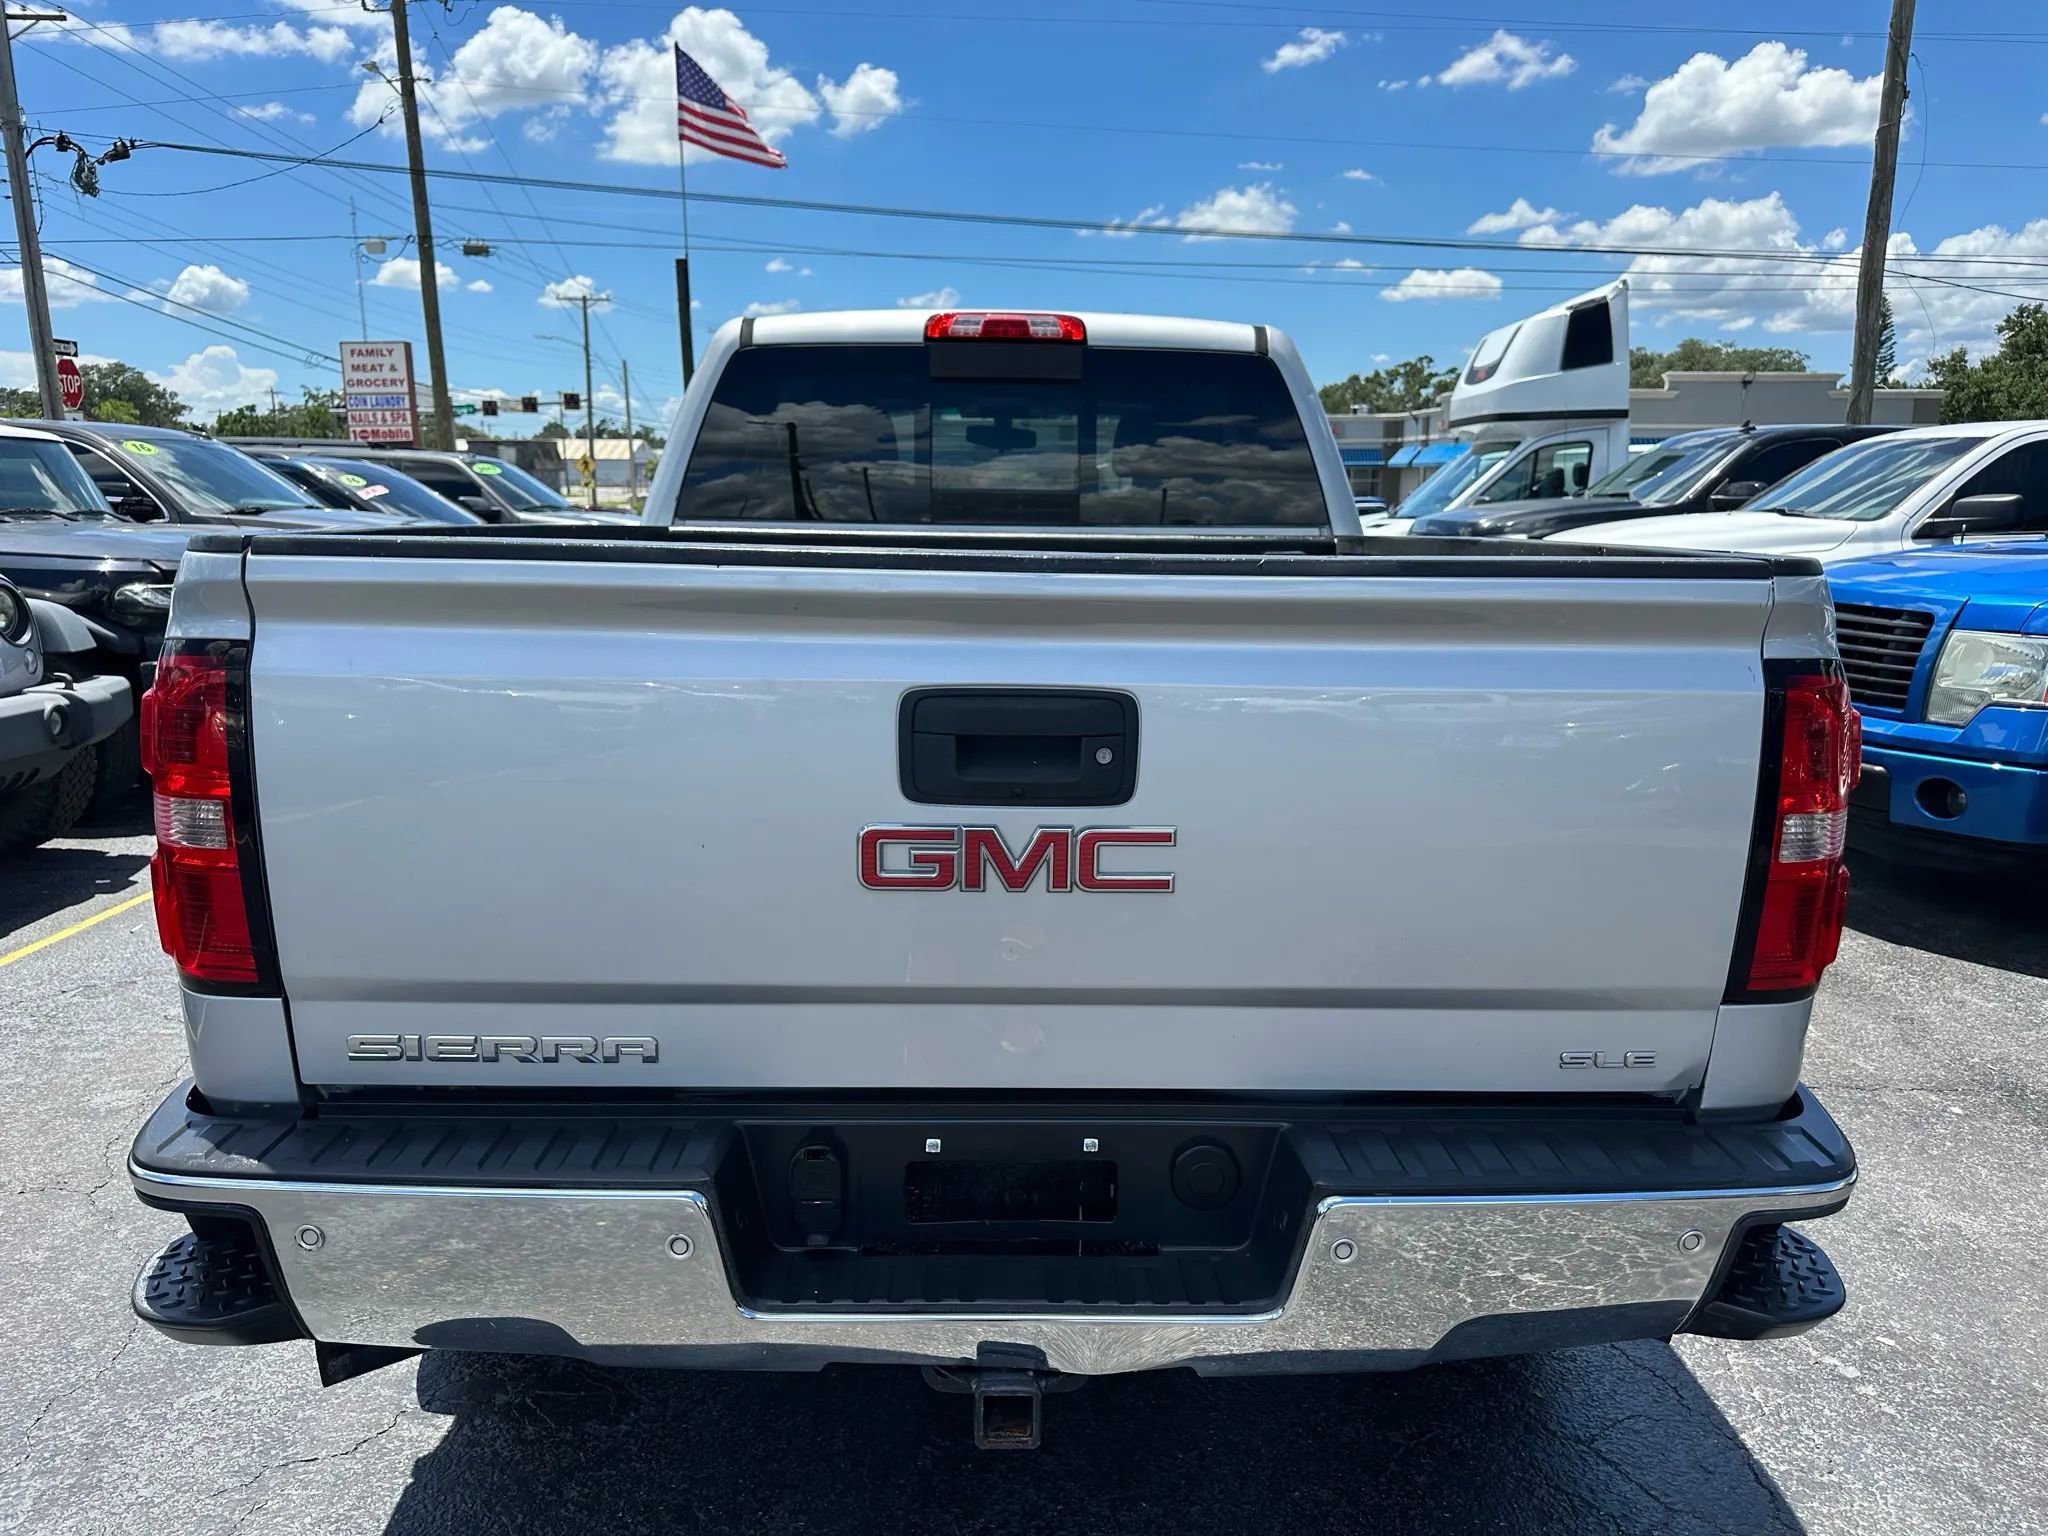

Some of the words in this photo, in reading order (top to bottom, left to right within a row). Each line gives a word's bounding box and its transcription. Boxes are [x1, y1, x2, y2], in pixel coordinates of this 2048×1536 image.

[350, 348, 394, 358] FAMILY
[351, 363, 384, 373] MEAT
[389, 363, 398, 373] &
[346, 378, 405, 388] GROCERY
[348, 395, 368, 407] COIN
[370, 395, 406, 407] LAUNDRY
[350, 412, 378, 424] NAILS
[381, 412, 388, 423] &
[392, 411, 408, 423] SPA
[371, 428, 410, 440] Mobile
[131, 443, 152, 452] 16
[857, 822, 1177, 893] GMC
[346, 1034, 659, 1063] SIERRA
[1559, 1050, 1657, 1069] SLE
